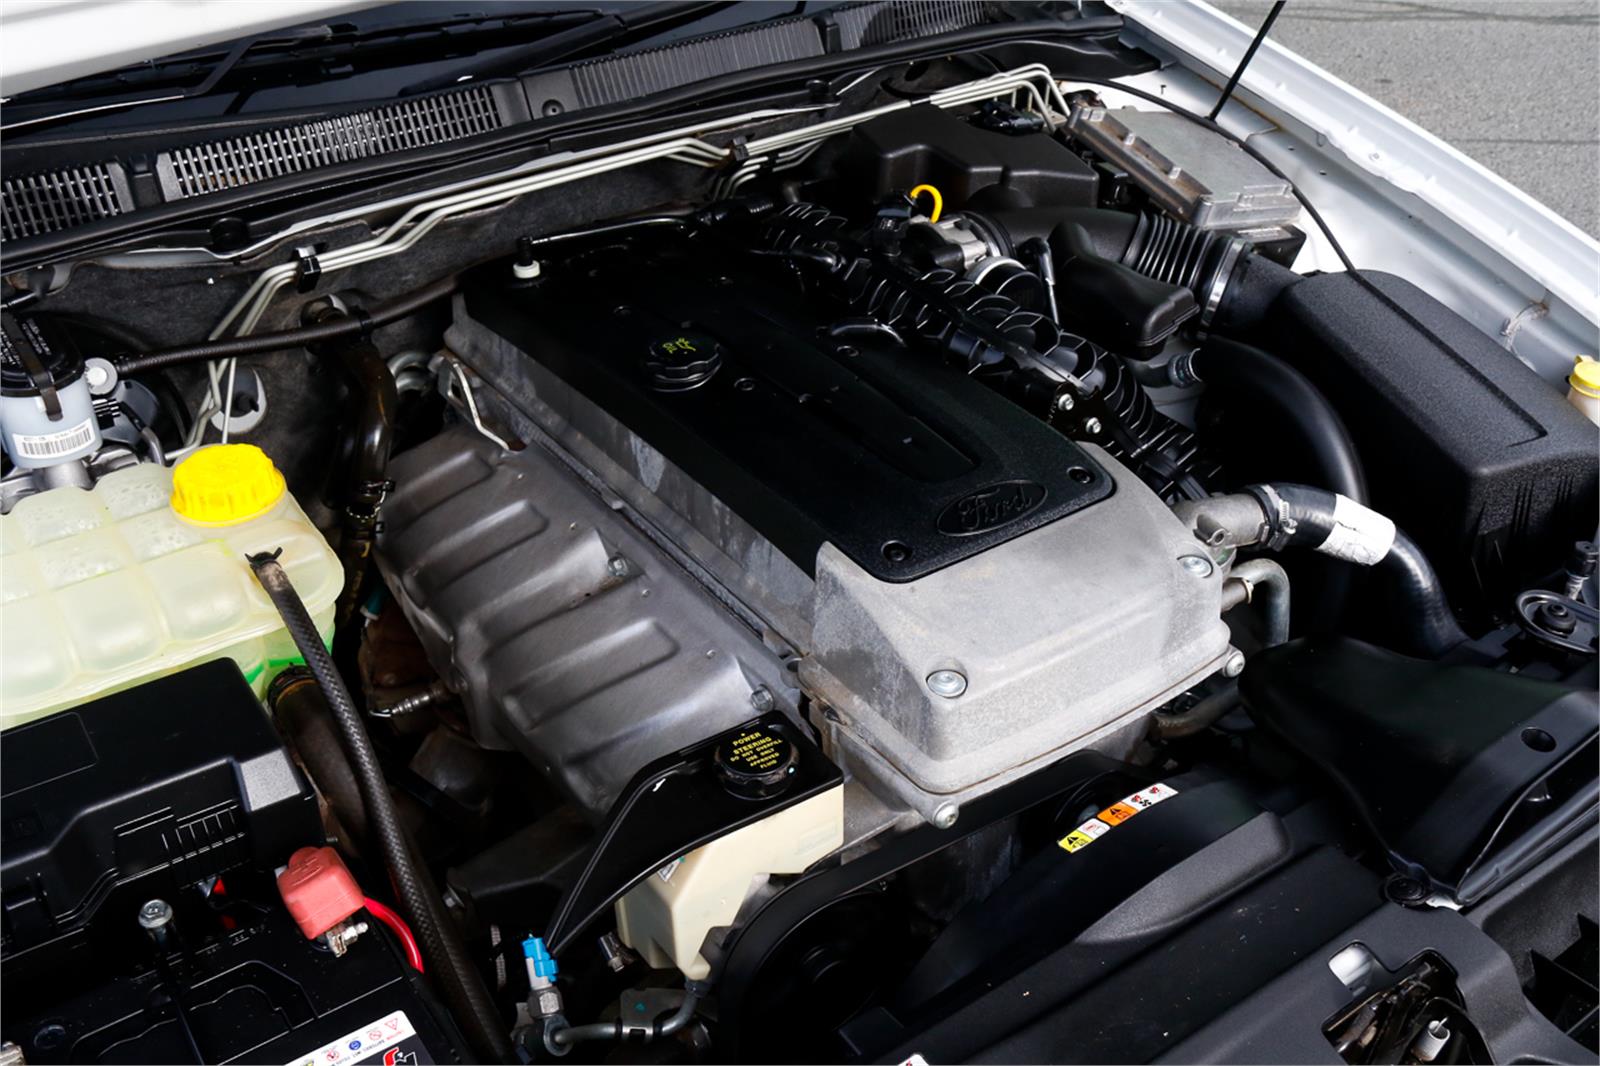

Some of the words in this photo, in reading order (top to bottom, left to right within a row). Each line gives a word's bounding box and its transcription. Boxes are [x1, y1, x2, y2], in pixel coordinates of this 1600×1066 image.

[959, 485, 1032, 530] Ford
[733, 732, 761, 746] POWER
[733, 737, 771, 754] STEERING
[760, 748, 774, 756] ONLY
[750, 752, 779, 767] APPROVED
[760, 760, 777, 769] FLUID
